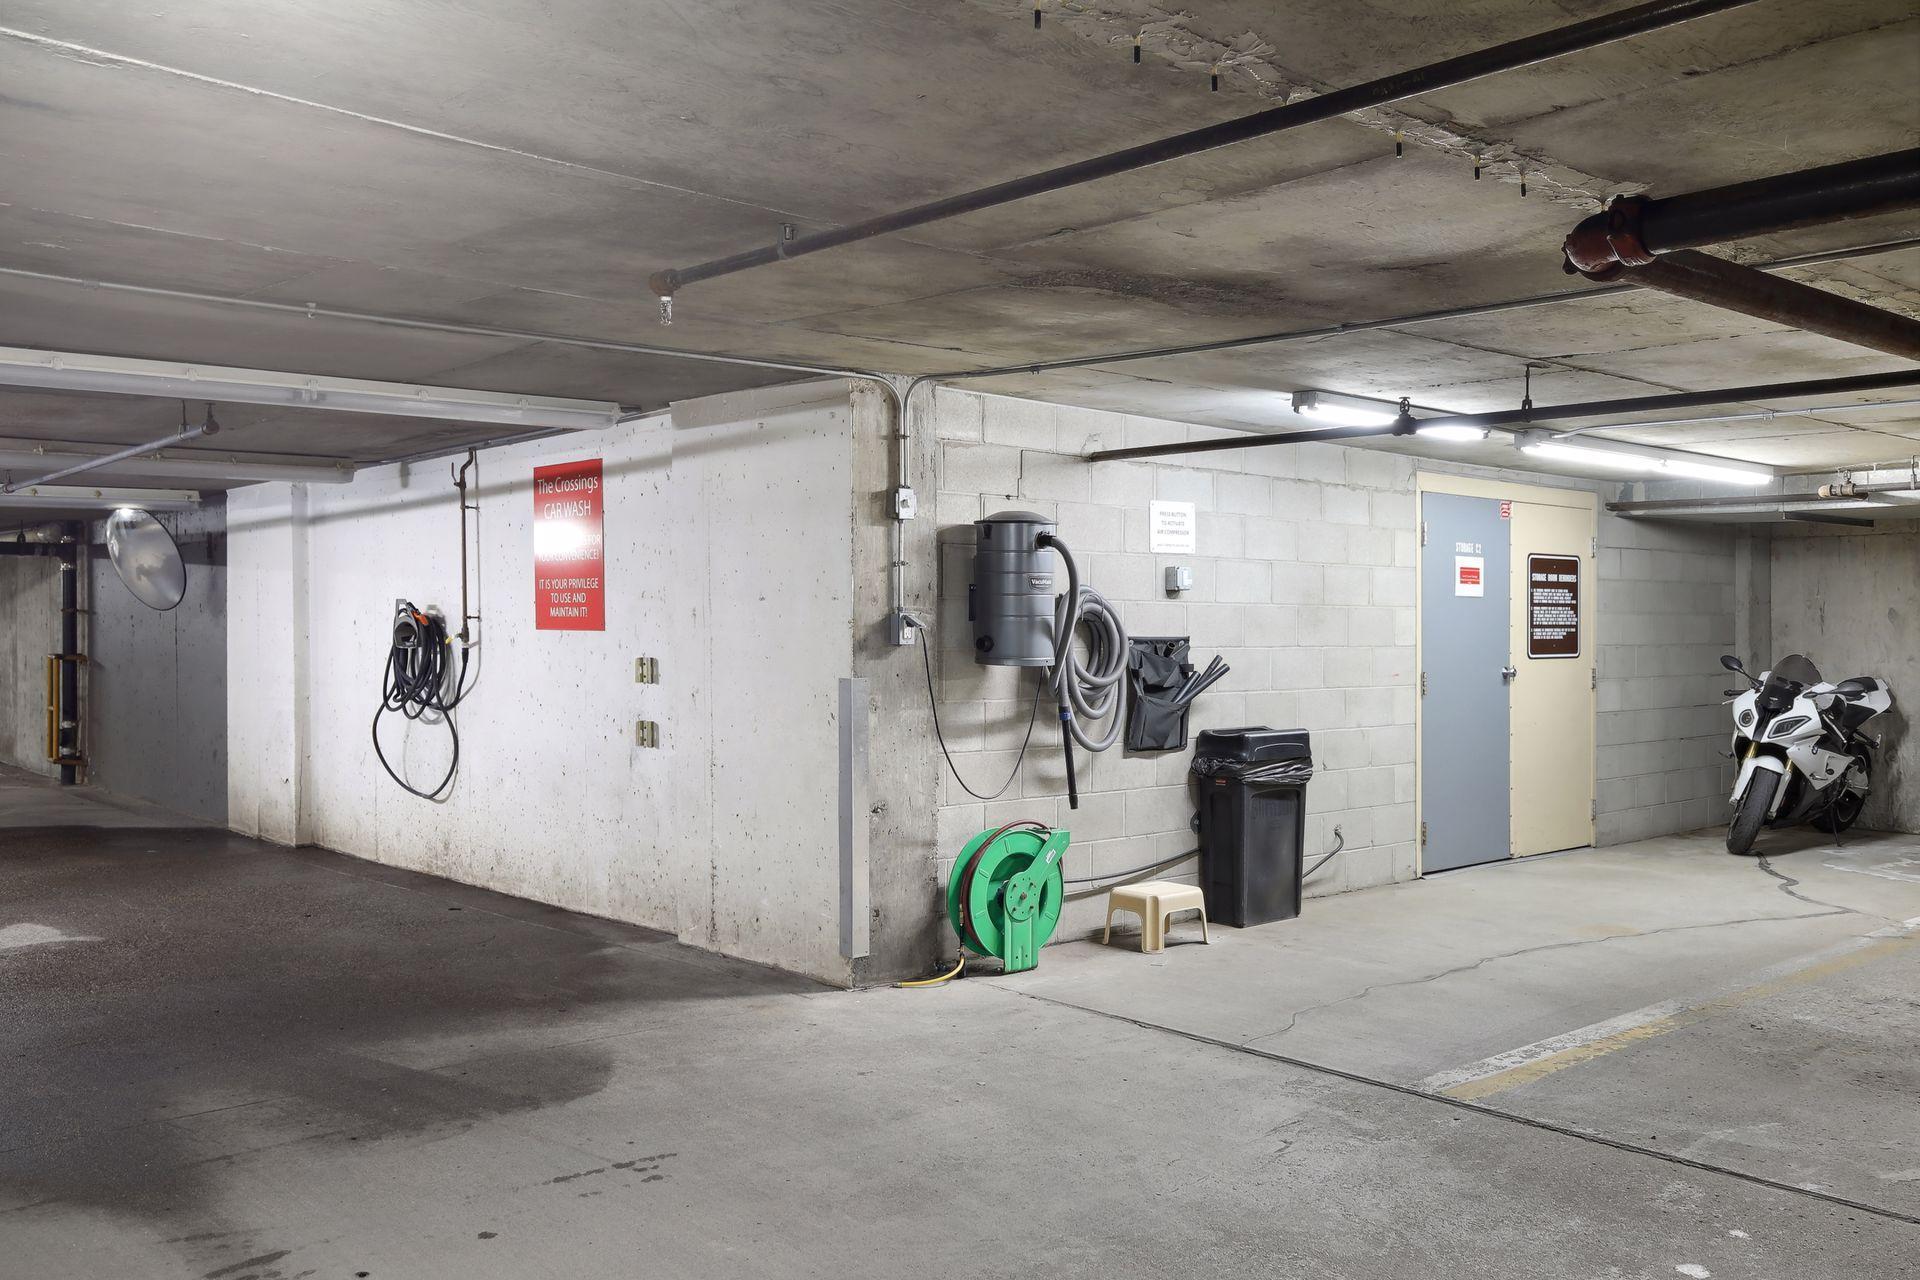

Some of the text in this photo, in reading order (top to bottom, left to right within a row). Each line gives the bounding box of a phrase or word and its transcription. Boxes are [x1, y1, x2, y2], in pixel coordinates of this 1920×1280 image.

[538, 475, 598, 495] The Crossings
[544, 500, 591, 520] CAR WASH
[588, 534, 601, 545] FOR
[1455, 542, 1474, 553] STORAGE
[1531, 573, 1547, 581] STORAGE
[538, 577, 599, 590] IT IS YOUR PRIVILEGE
[551, 592, 586, 603] TO USE AND
[550, 606, 588, 617] MAINTAIN IT!
